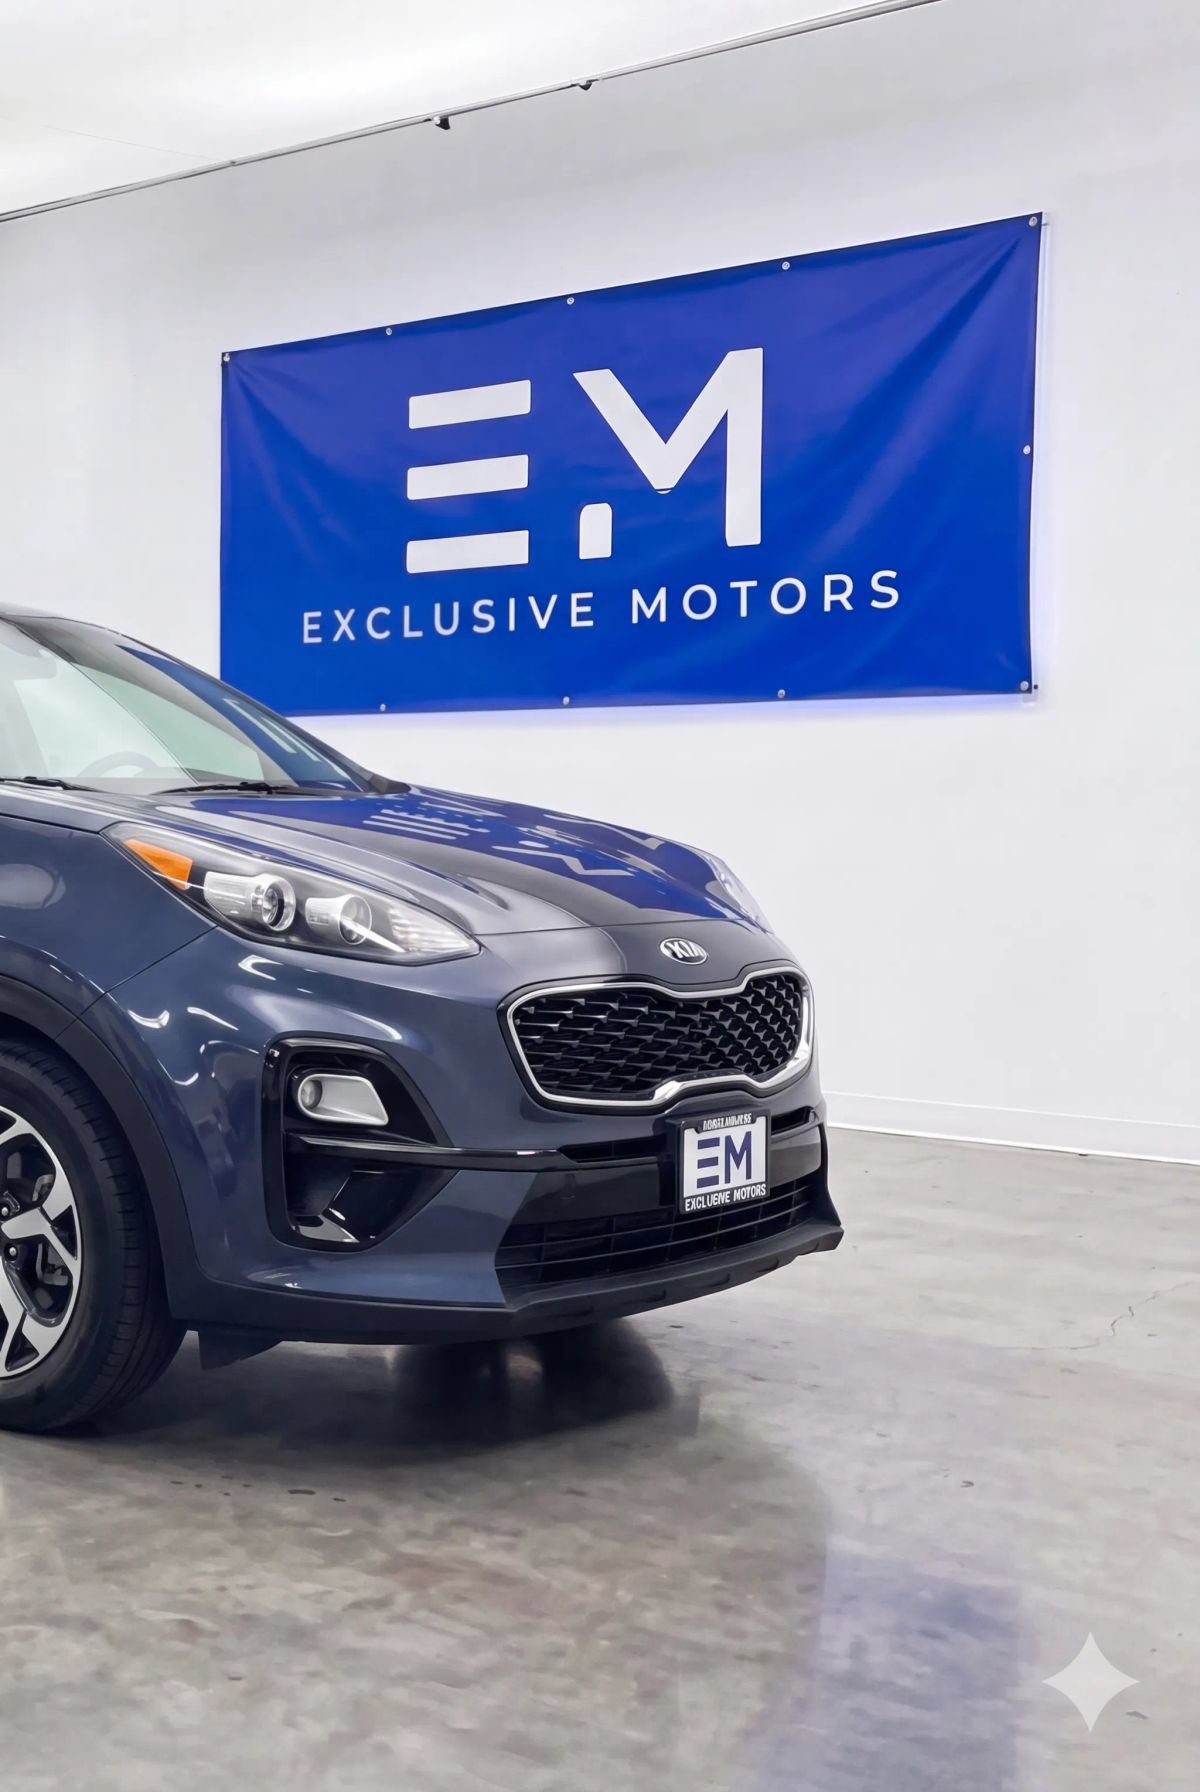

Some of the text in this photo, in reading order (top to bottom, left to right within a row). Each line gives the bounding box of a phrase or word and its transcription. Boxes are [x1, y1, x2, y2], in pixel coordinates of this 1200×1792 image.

[406, 348, 763, 574] EM
[303, 569, 899, 644] EXCLUSIVE MOTORS
[697, 1130, 752, 1189] EM
[733, 1183, 767, 1202] MOTORS
